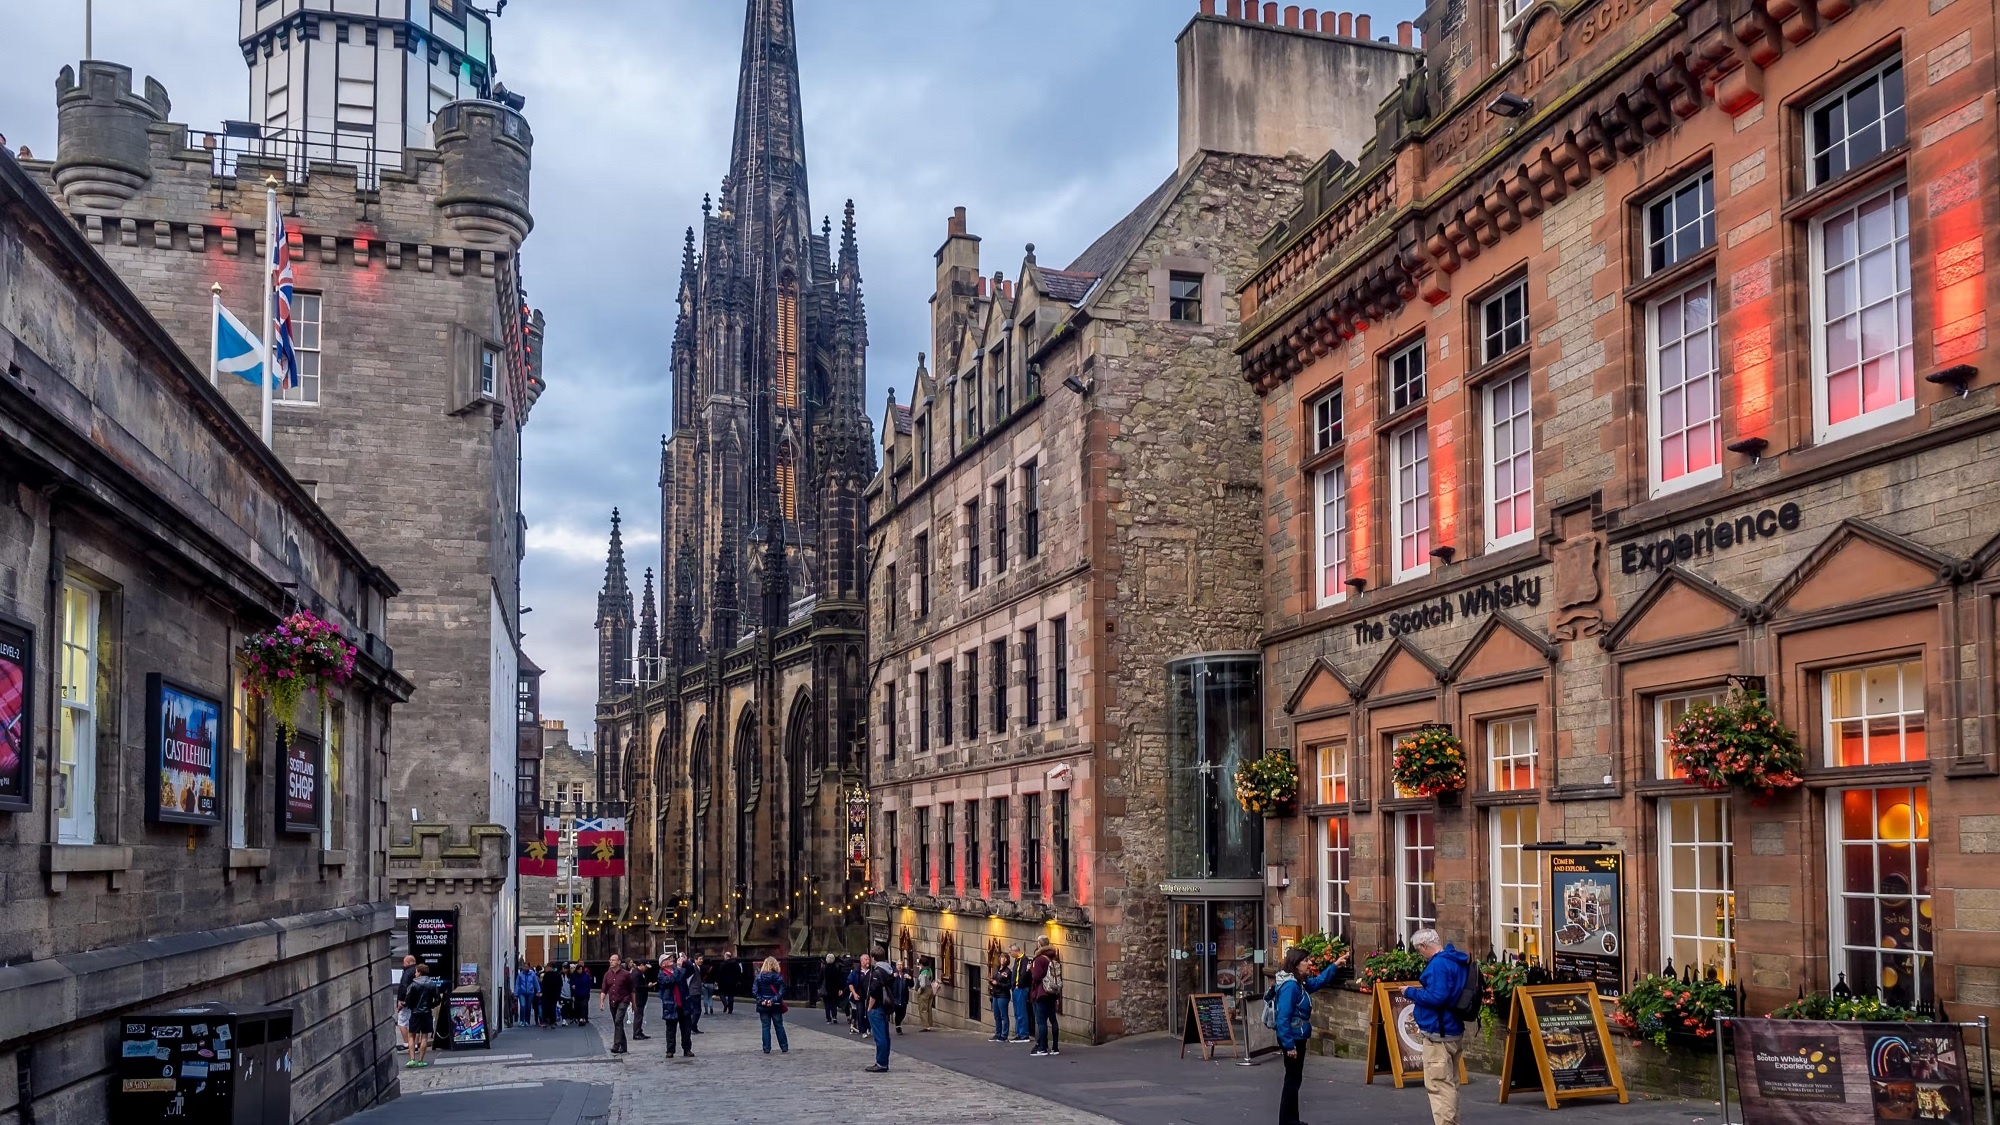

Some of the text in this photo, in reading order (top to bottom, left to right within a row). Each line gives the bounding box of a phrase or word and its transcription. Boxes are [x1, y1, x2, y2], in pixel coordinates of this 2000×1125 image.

[1434, 84, 1508, 162] CASTL
[1522, 40, 1569, 95] HILL
[1353, 501, 1801, 645] The Scotch Whisky Experience
[165, 738, 211, 768] CASTLEHILL
[289, 757, 314, 776] SCOTLAND
[289, 772, 314, 800] SHOP
[1553, 857, 1568, 865] COME
[1898, 915, 1910, 924] the
[1918, 920, 1931, 933] orld
[1774, 1062, 1815, 1070] Experience
[1780, 1056, 1808, 1064] Whisky
